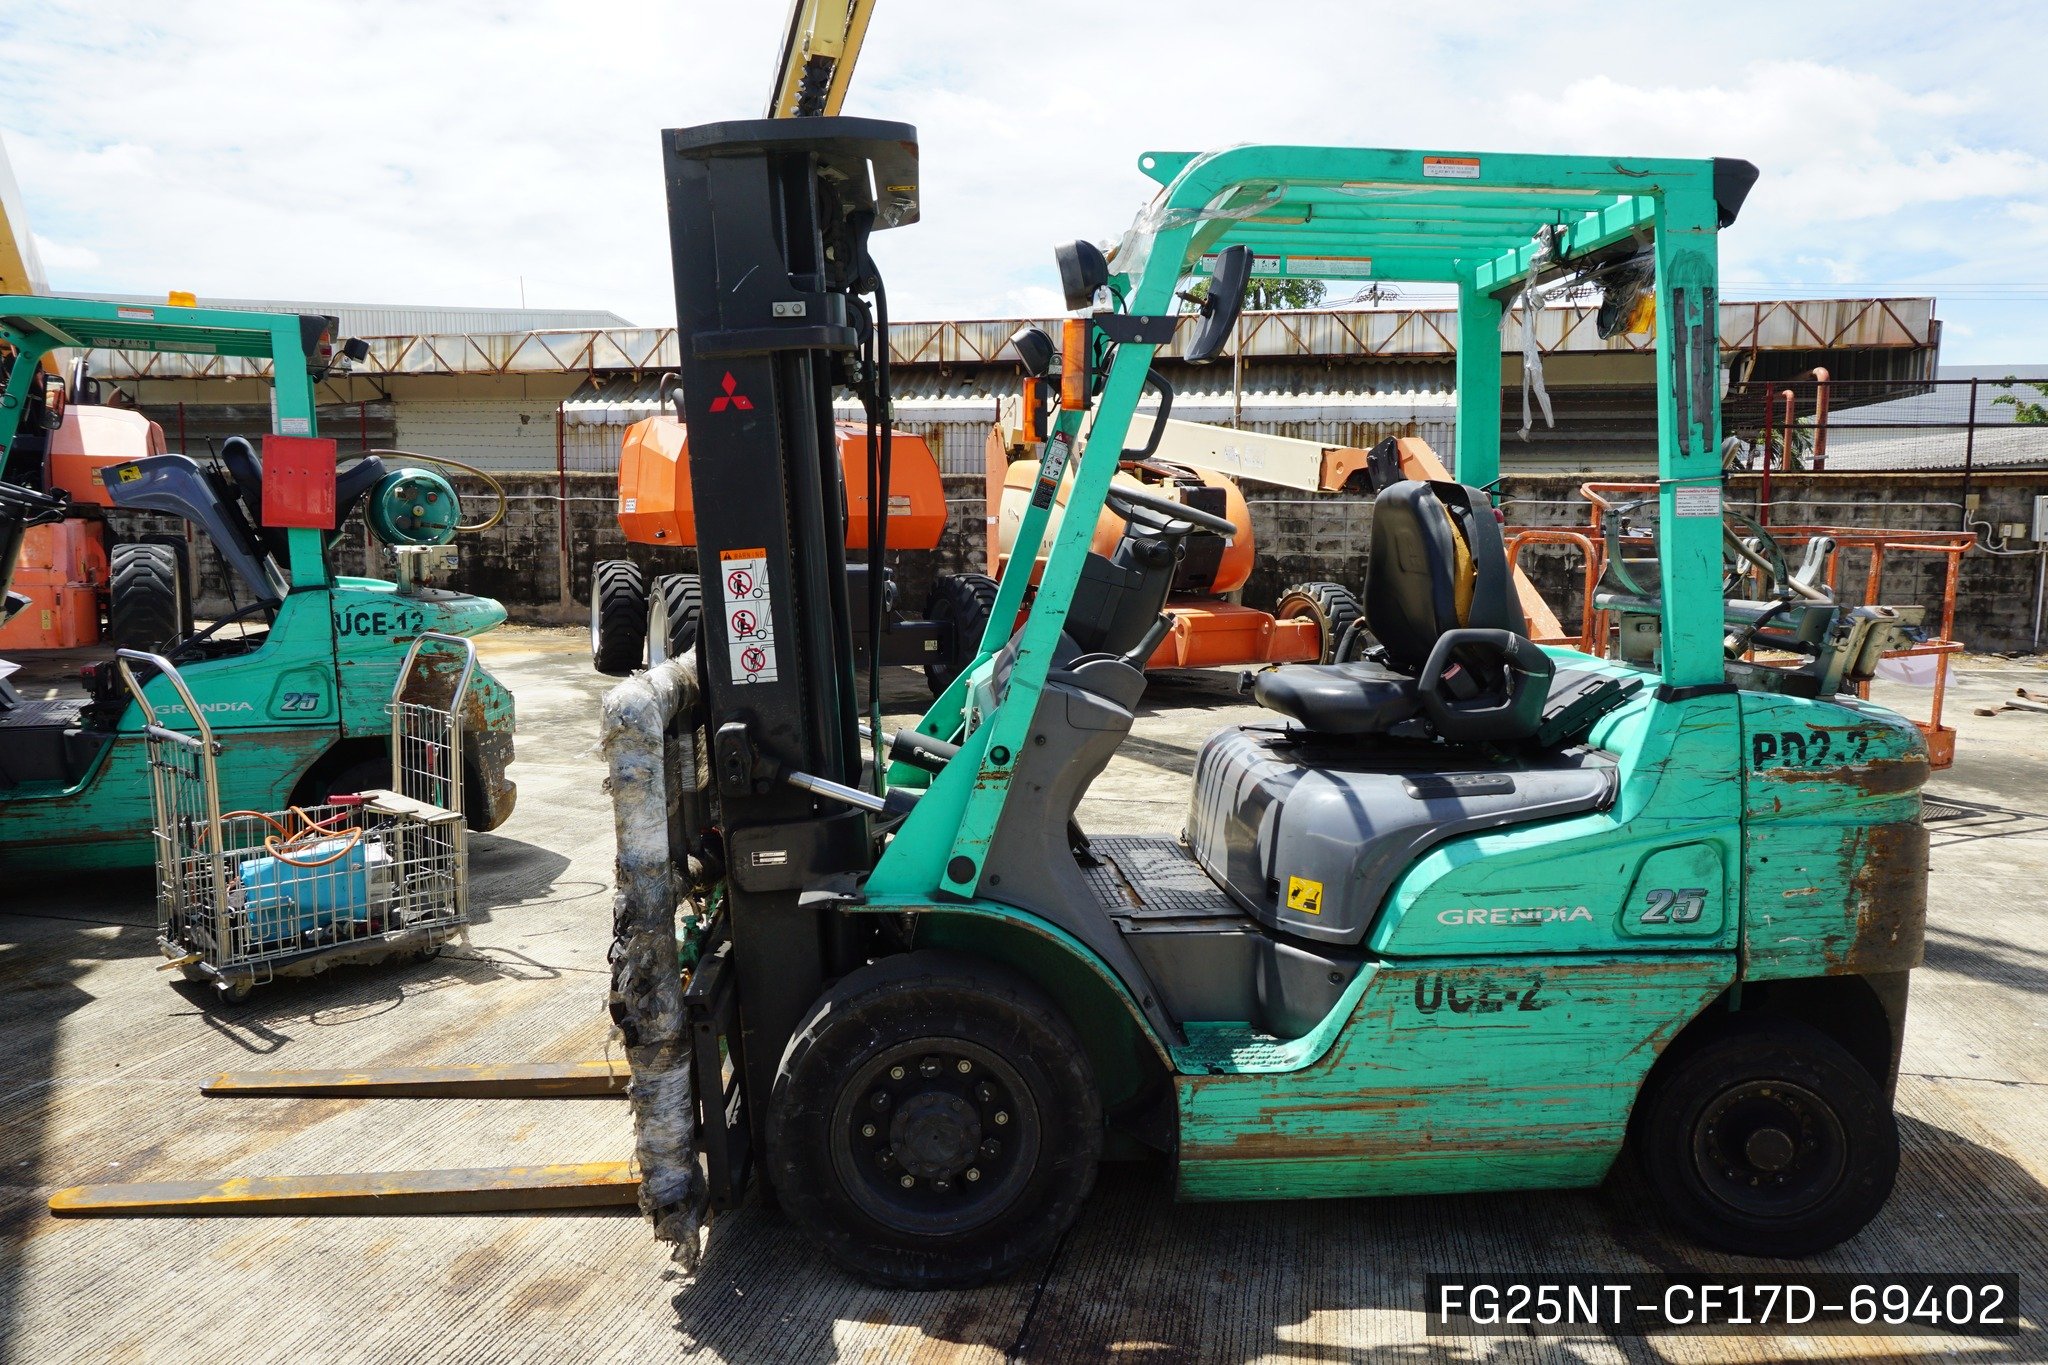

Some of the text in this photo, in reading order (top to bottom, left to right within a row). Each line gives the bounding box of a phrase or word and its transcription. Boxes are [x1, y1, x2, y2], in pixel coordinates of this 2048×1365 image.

[734, 551, 764, 559] WARNING
[334, 611, 424, 637] UCE-12
[281, 693, 320, 711] 25
[1640, 888, 1708, 923] 25
